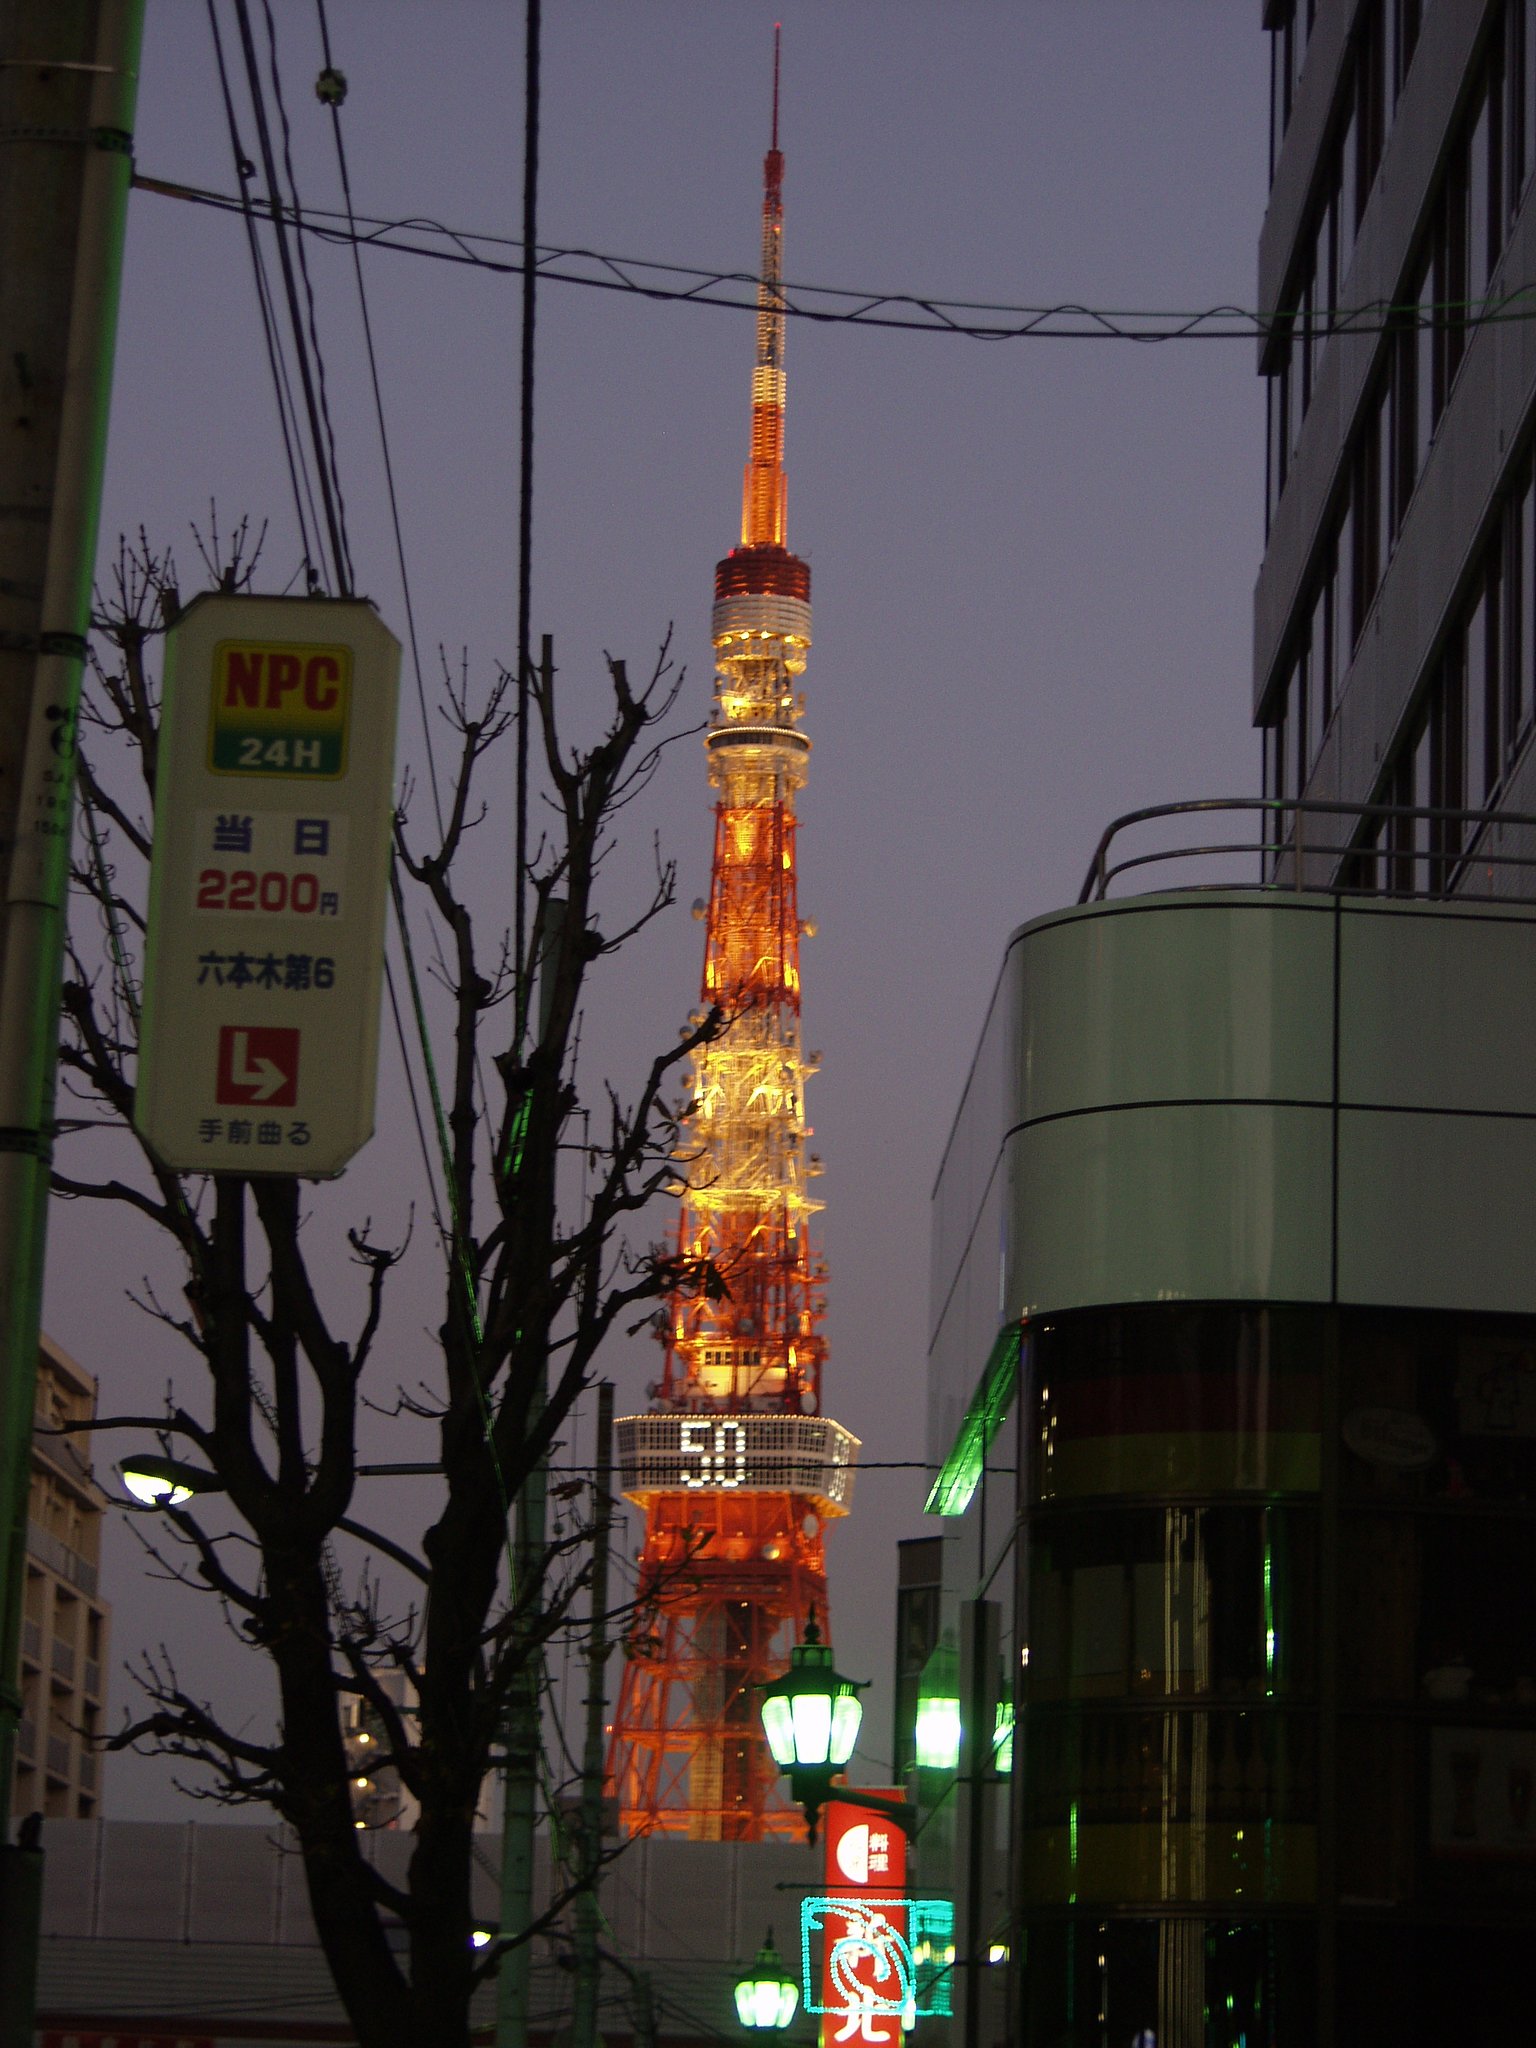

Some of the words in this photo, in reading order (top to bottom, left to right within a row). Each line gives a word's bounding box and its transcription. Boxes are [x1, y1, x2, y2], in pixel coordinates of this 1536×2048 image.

[224, 650, 340, 712] NPC
[238, 737, 322, 769] 24H
[196, 868, 340, 917] 2200円
[197, 950, 335, 990] 六本木第6
[199, 1118, 312, 1147] 手前曲る
[680, 1420, 746, 1488] 50
